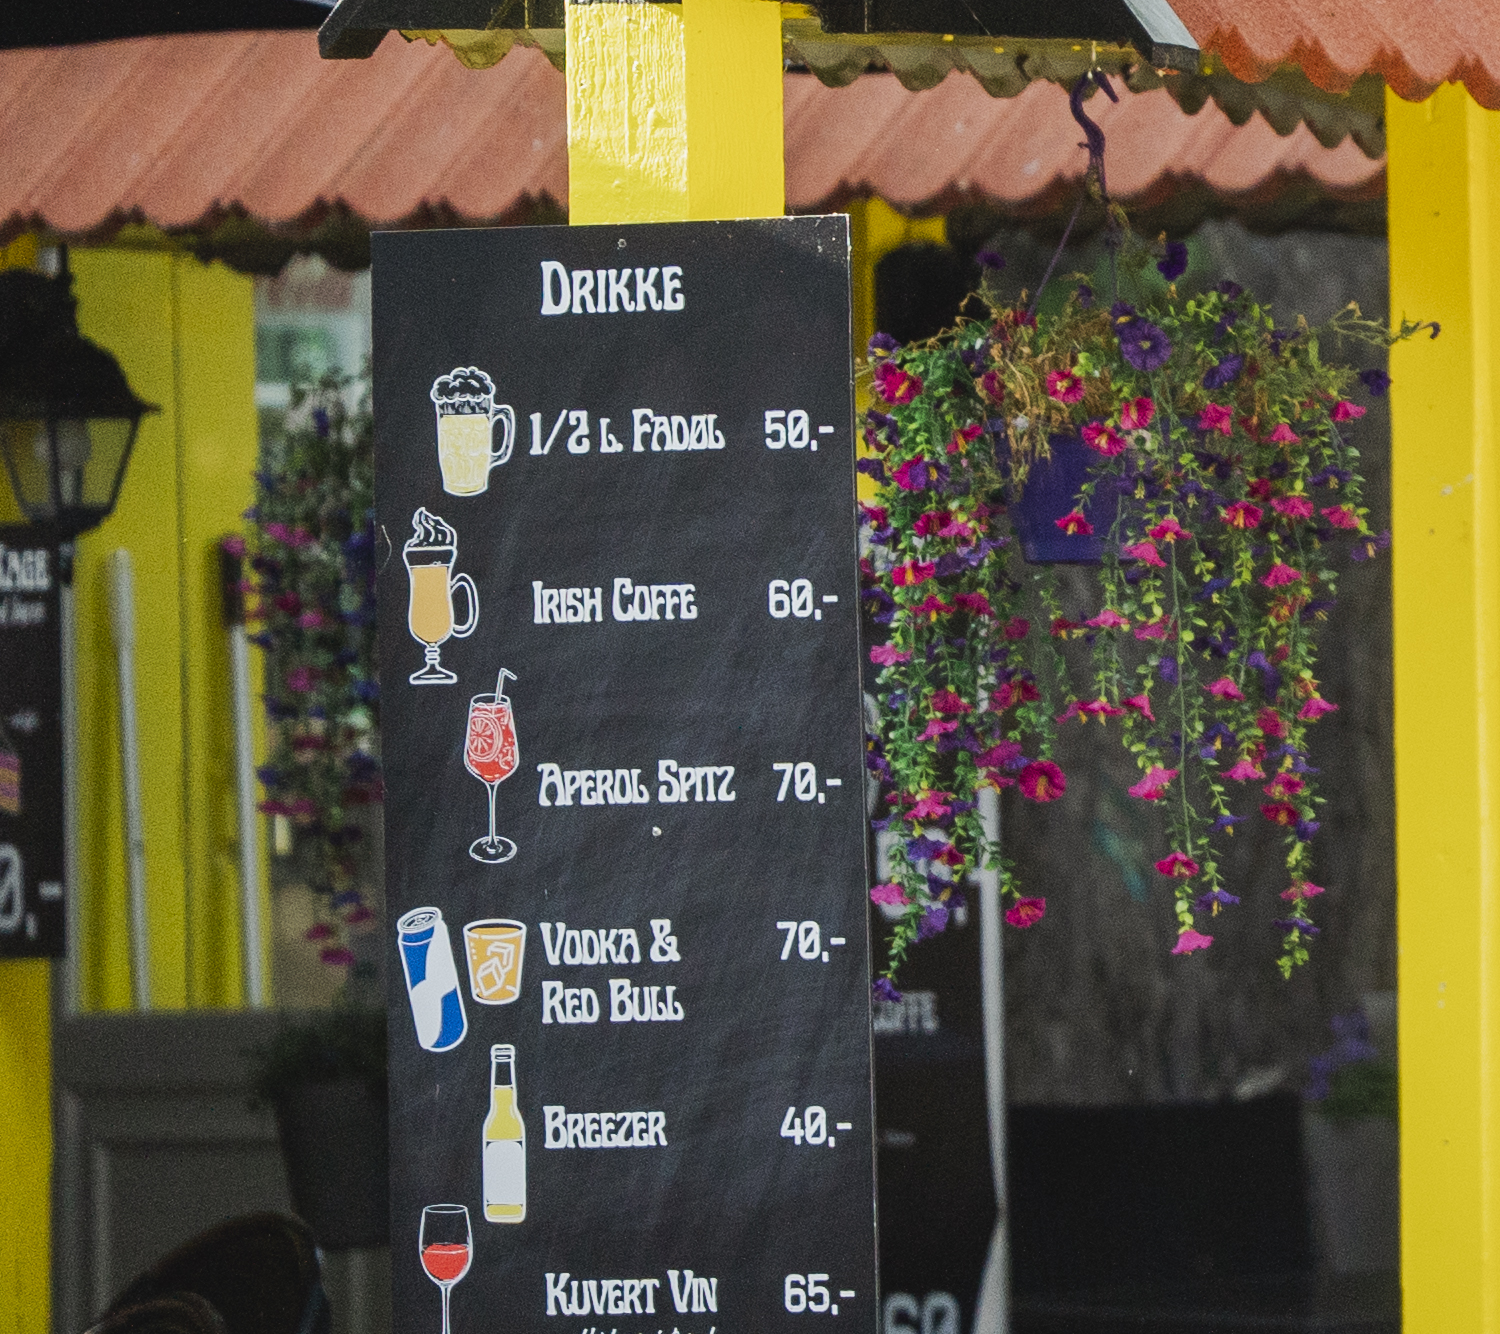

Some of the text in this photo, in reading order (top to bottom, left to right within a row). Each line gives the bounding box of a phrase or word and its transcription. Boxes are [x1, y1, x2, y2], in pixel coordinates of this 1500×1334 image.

[540, 260, 686, 315] DRIKKE
[530, 409, 590, 455] 1/2
[632, 409, 726, 453] FADØL
[532, 580, 603, 624] IRISH
[612, 577, 697, 622] COFFE
[537, 762, 650, 806] APEROL
[540, 922, 642, 965] VODKA
[649, 919, 681, 962] &
[541, 978, 685, 1024] RED BULL
[543, 1105, 668, 1149] BREEZER
[545, 1272, 660, 1316] KUVERT
[666, 1269, 718, 1313] VIN
